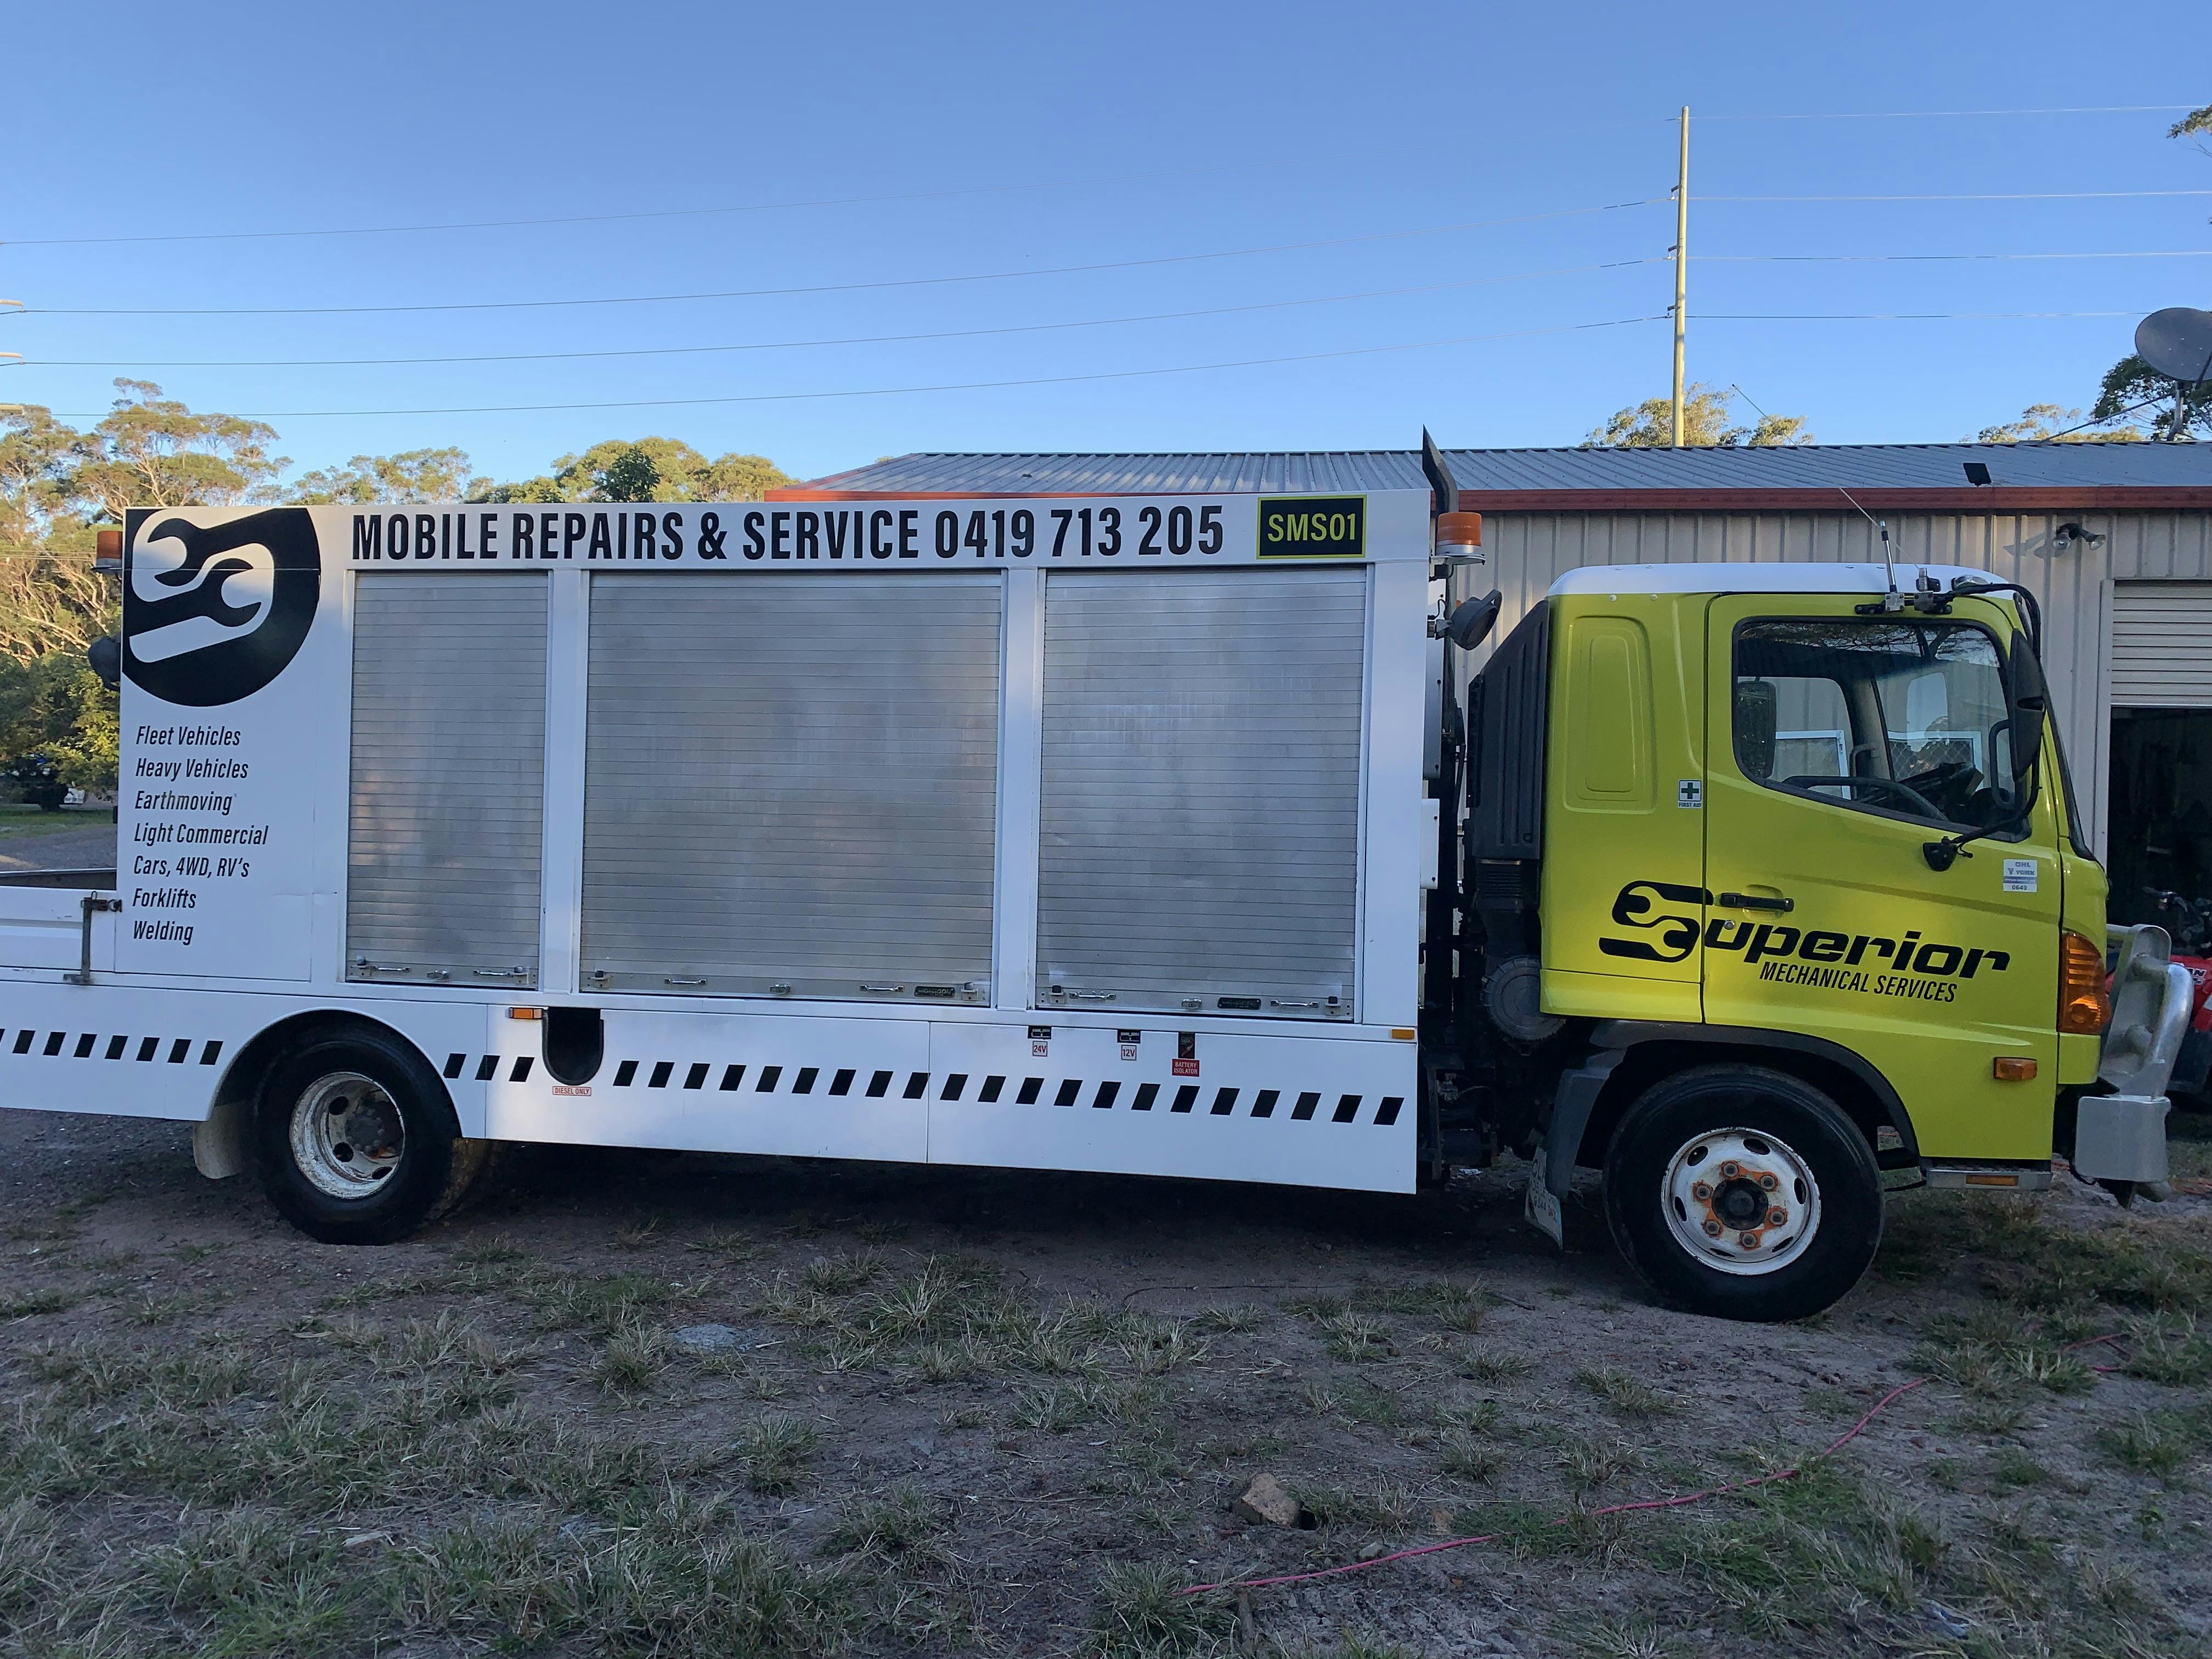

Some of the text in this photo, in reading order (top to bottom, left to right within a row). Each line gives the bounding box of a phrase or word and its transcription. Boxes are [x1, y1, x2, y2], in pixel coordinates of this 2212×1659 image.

[352, 505, 1223, 561] MOBILE REPAIRS & SERVICE 0419 713 205
[1267, 512, 1356, 543] SMS01
[136, 725, 241, 746] Fleet Vehicles
[136, 758, 249, 782] Heavy Vehicles
[135, 790, 232, 816] Earthmoving
[134, 822, 269, 847] Light Commercial
[134, 855, 250, 878] Cars, 4WD, RV's
[132, 888, 196, 909] Forklifts
[133, 920, 193, 945] Welding
[1599, 880, 2010, 979] Superior
[1759, 961, 1957, 1003] MECHANICAL SERVICES
[1034, 1045, 1047, 1053] 24V
[1122, 1048, 1136, 1057] 12V
